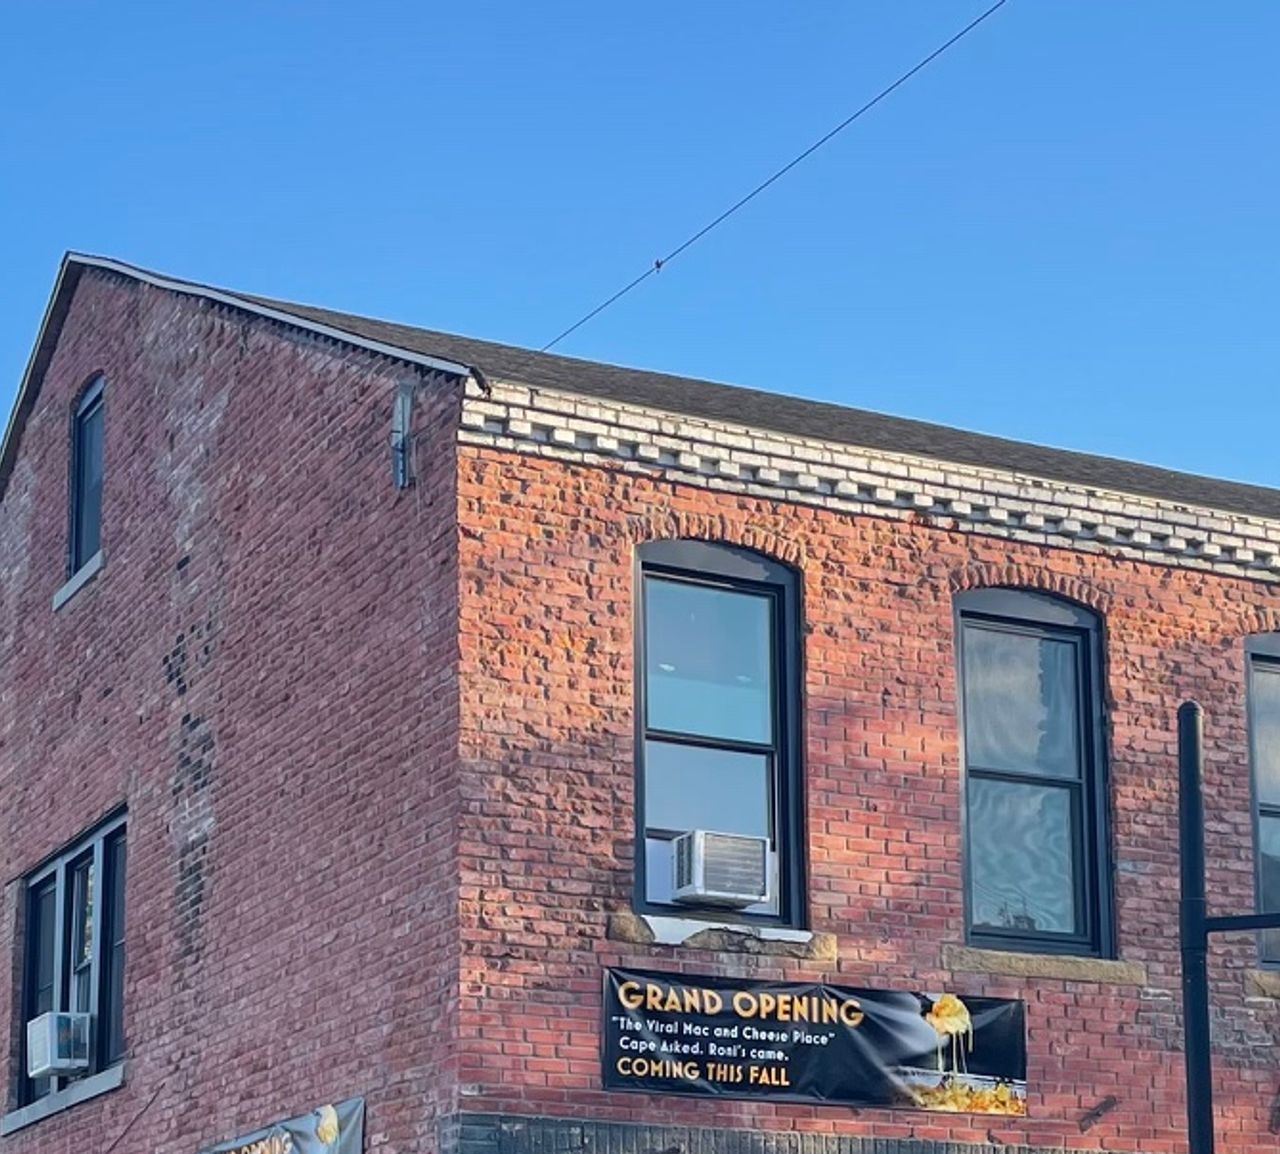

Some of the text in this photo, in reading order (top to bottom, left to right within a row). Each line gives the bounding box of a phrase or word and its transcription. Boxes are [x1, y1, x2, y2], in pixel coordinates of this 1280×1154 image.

[618, 981, 864, 1027] GRAND OPENING
[646, 1018, 678, 1034] Viral
[682, 1021, 710, 1036] Mac
[713, 1025, 738, 1039] and
[742, 1026, 788, 1042] Cheese
[619, 1035, 789, 1061] Cape Asked. Roni's came.
[616, 1056, 790, 1086] COMING THIS FALL
